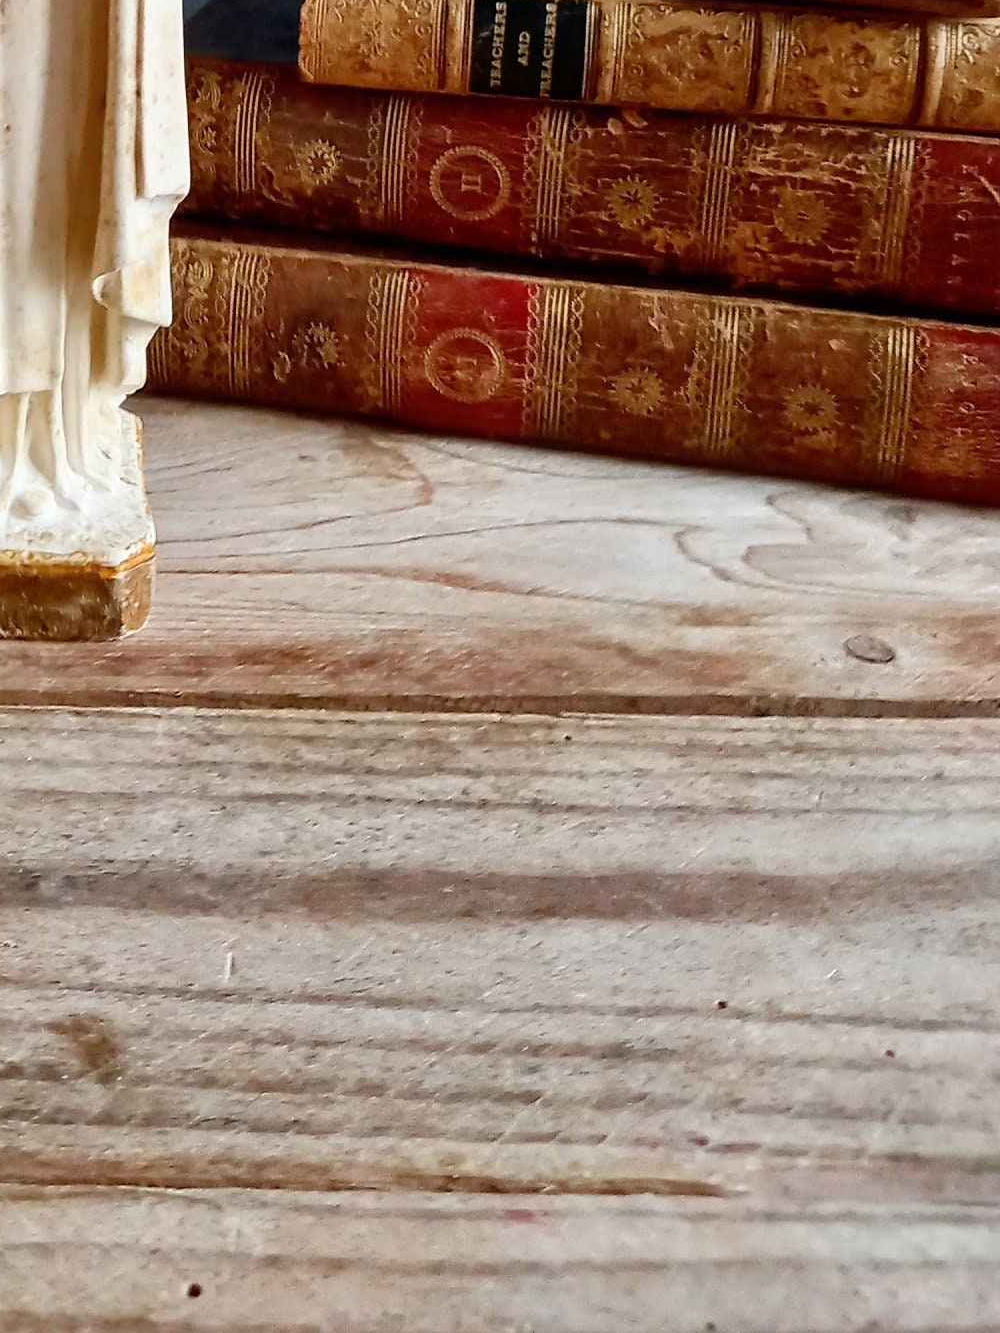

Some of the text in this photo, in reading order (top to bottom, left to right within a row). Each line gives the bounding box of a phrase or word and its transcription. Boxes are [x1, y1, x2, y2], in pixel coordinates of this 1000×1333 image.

[489, 1, 508, 87] TEACHERS
[517, 30, 531, 66] AND
[460, 171, 482, 194] II
